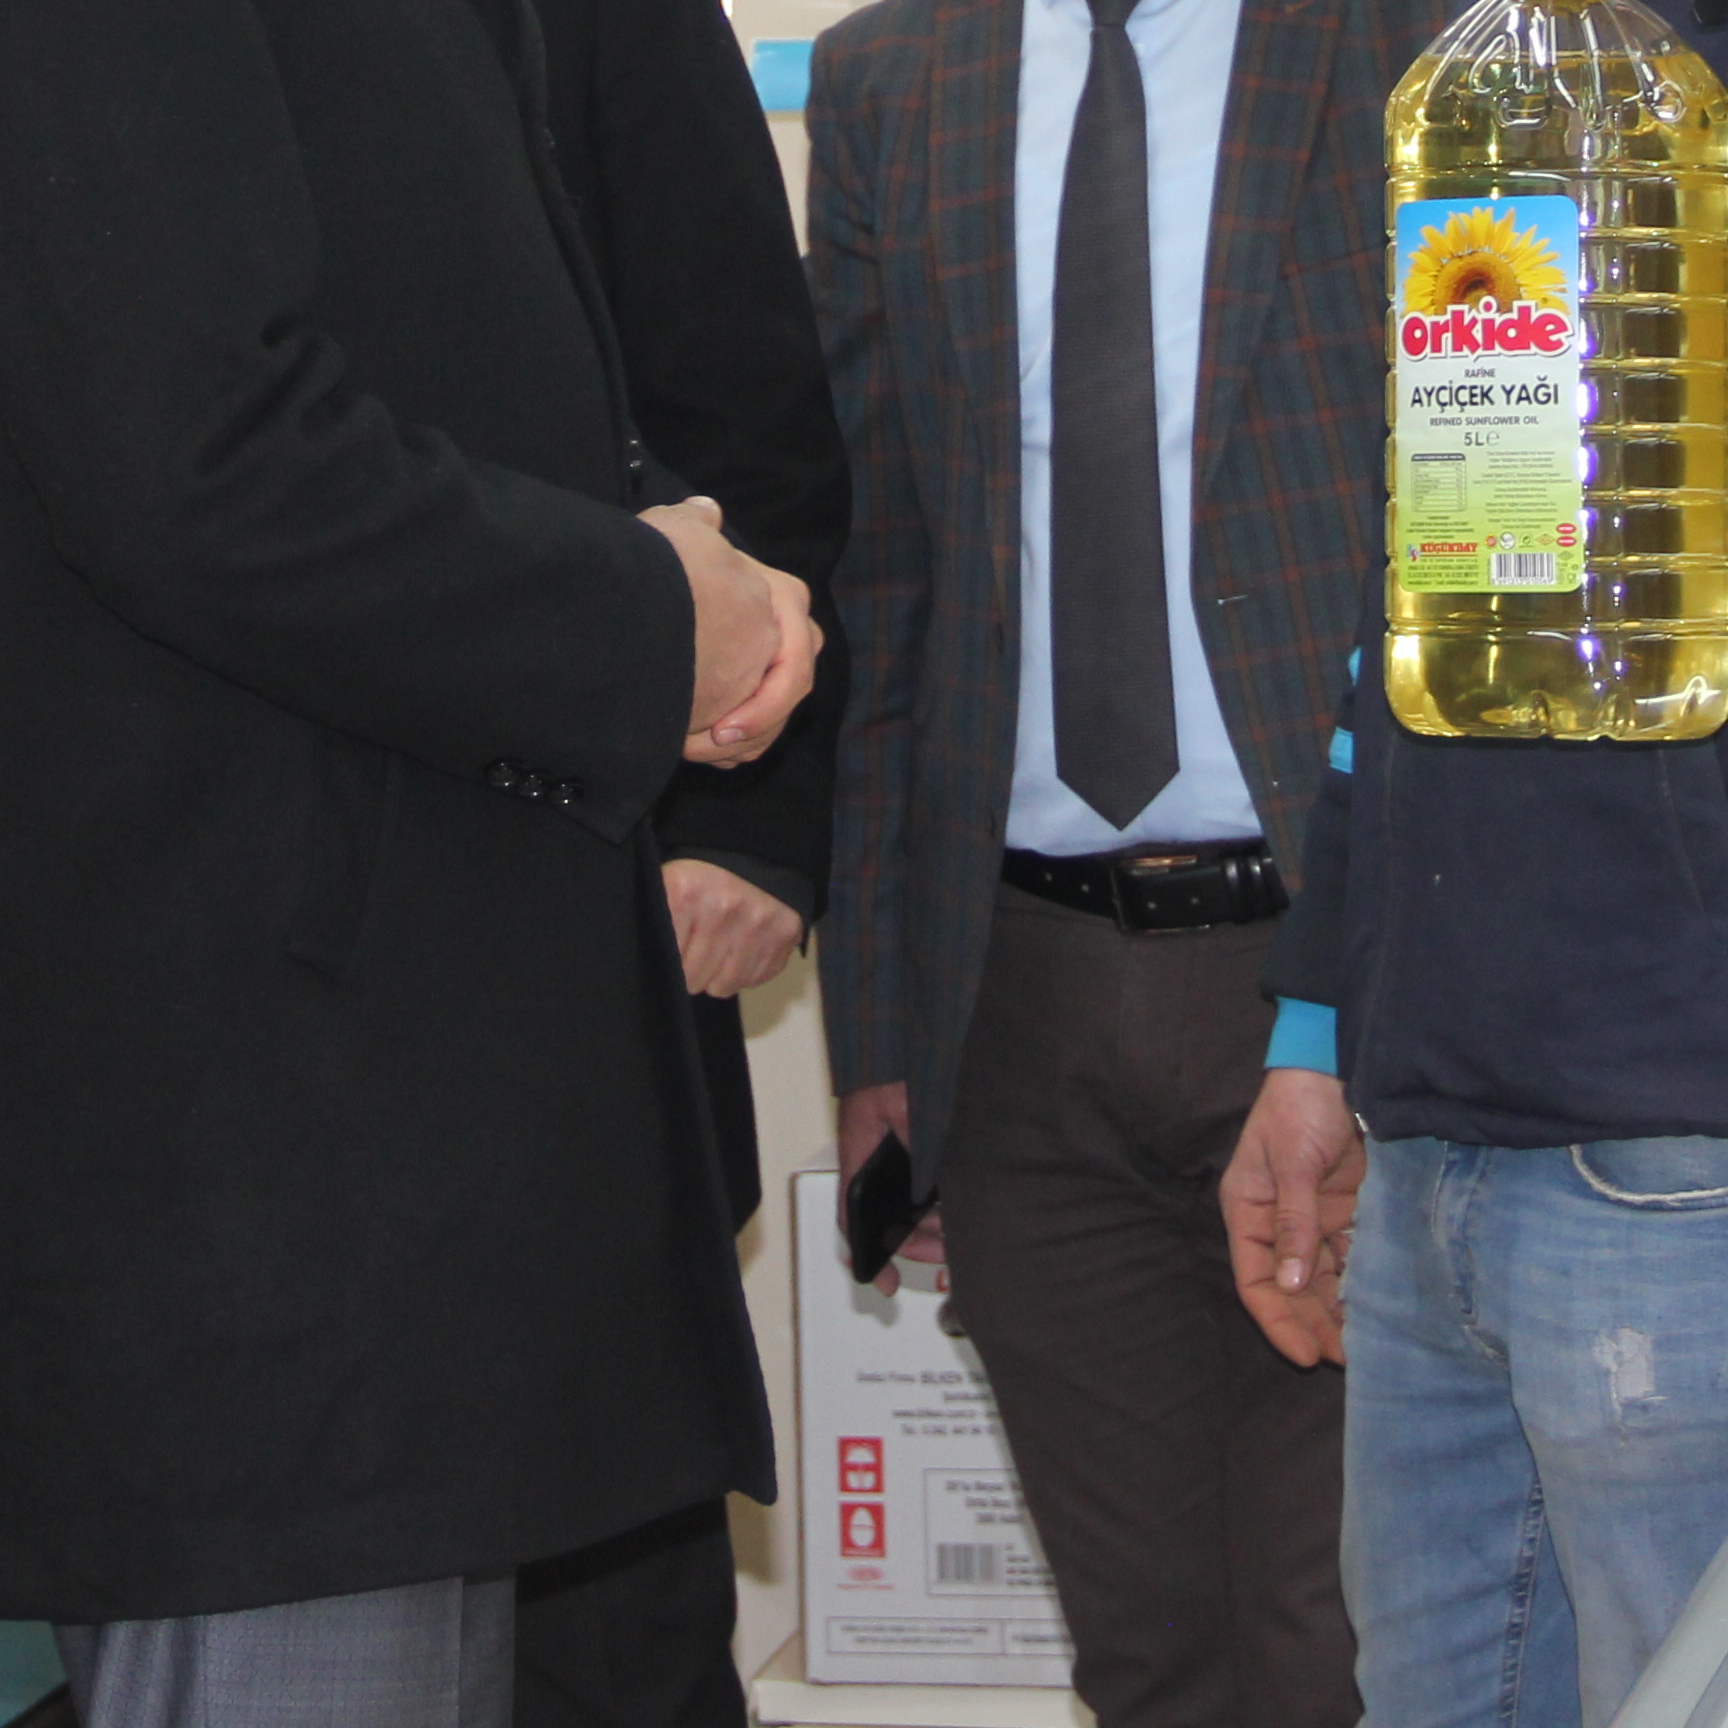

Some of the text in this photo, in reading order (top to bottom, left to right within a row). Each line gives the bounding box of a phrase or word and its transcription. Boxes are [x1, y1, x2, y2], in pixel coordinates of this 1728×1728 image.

[1402, 300, 1570, 357] orkide
[1464, 366, 1496, 378] RAFİNE
[1410, 375, 1559, 413] AYÇİÇEK YAĞI
[1430, 415, 1539, 426] REFINED SUNFLOWER OIL
